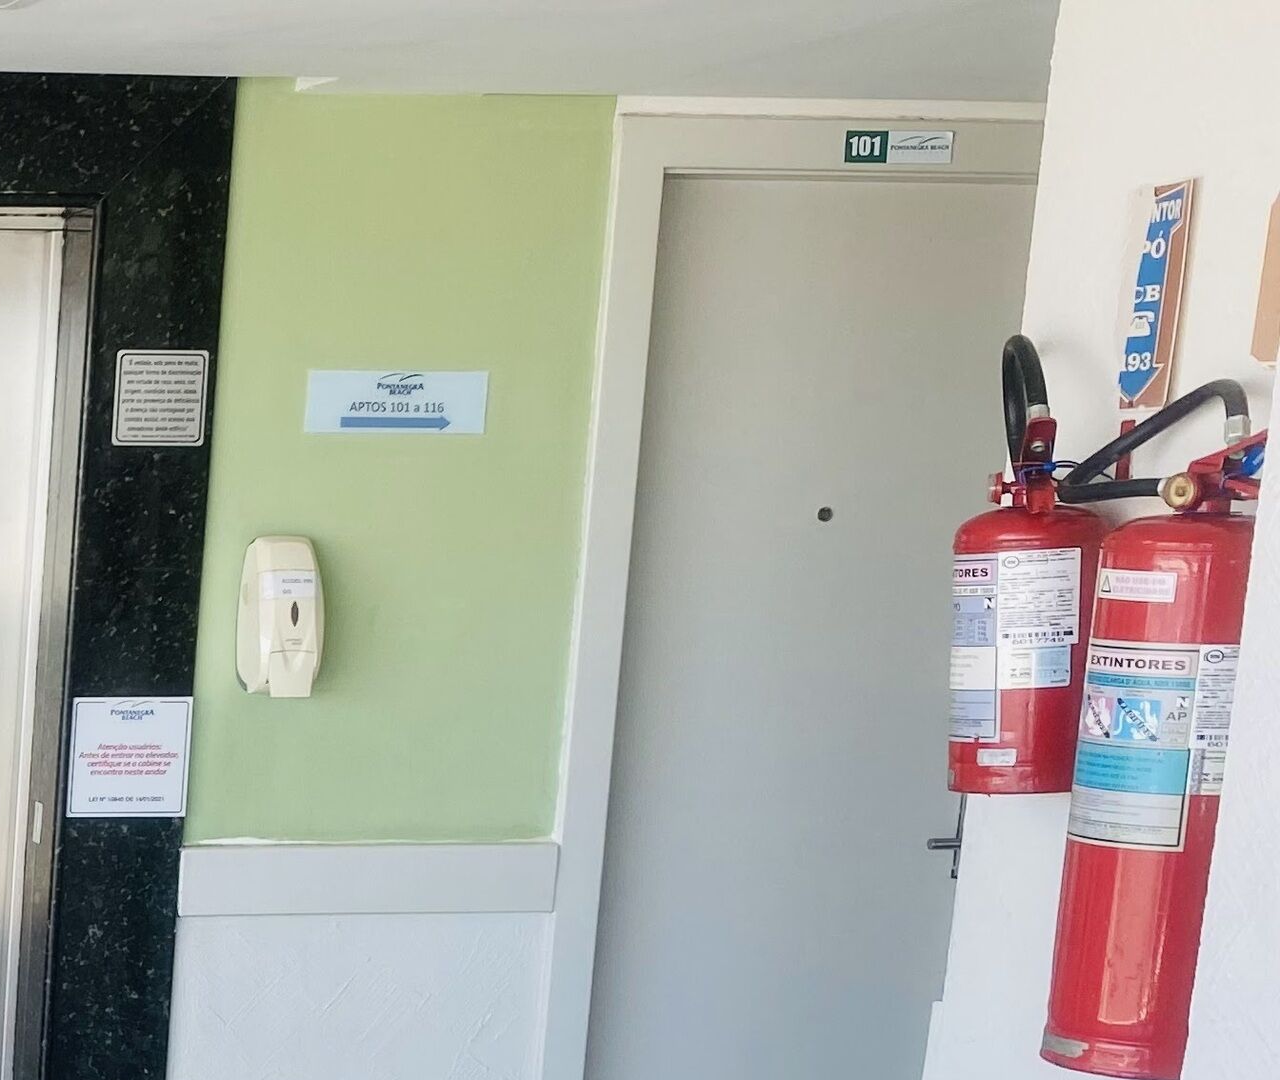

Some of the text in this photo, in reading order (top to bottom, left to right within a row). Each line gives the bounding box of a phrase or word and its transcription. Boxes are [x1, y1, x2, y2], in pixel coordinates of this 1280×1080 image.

[849, 136, 881, 156] 101
[377, 382, 424, 391] PONTANEGRA
[349, 402, 444, 414] APTOS 101 a 116
[1091, 654, 1186, 671] EXTINTORES
[1166, 711, 1188, 721] AP
